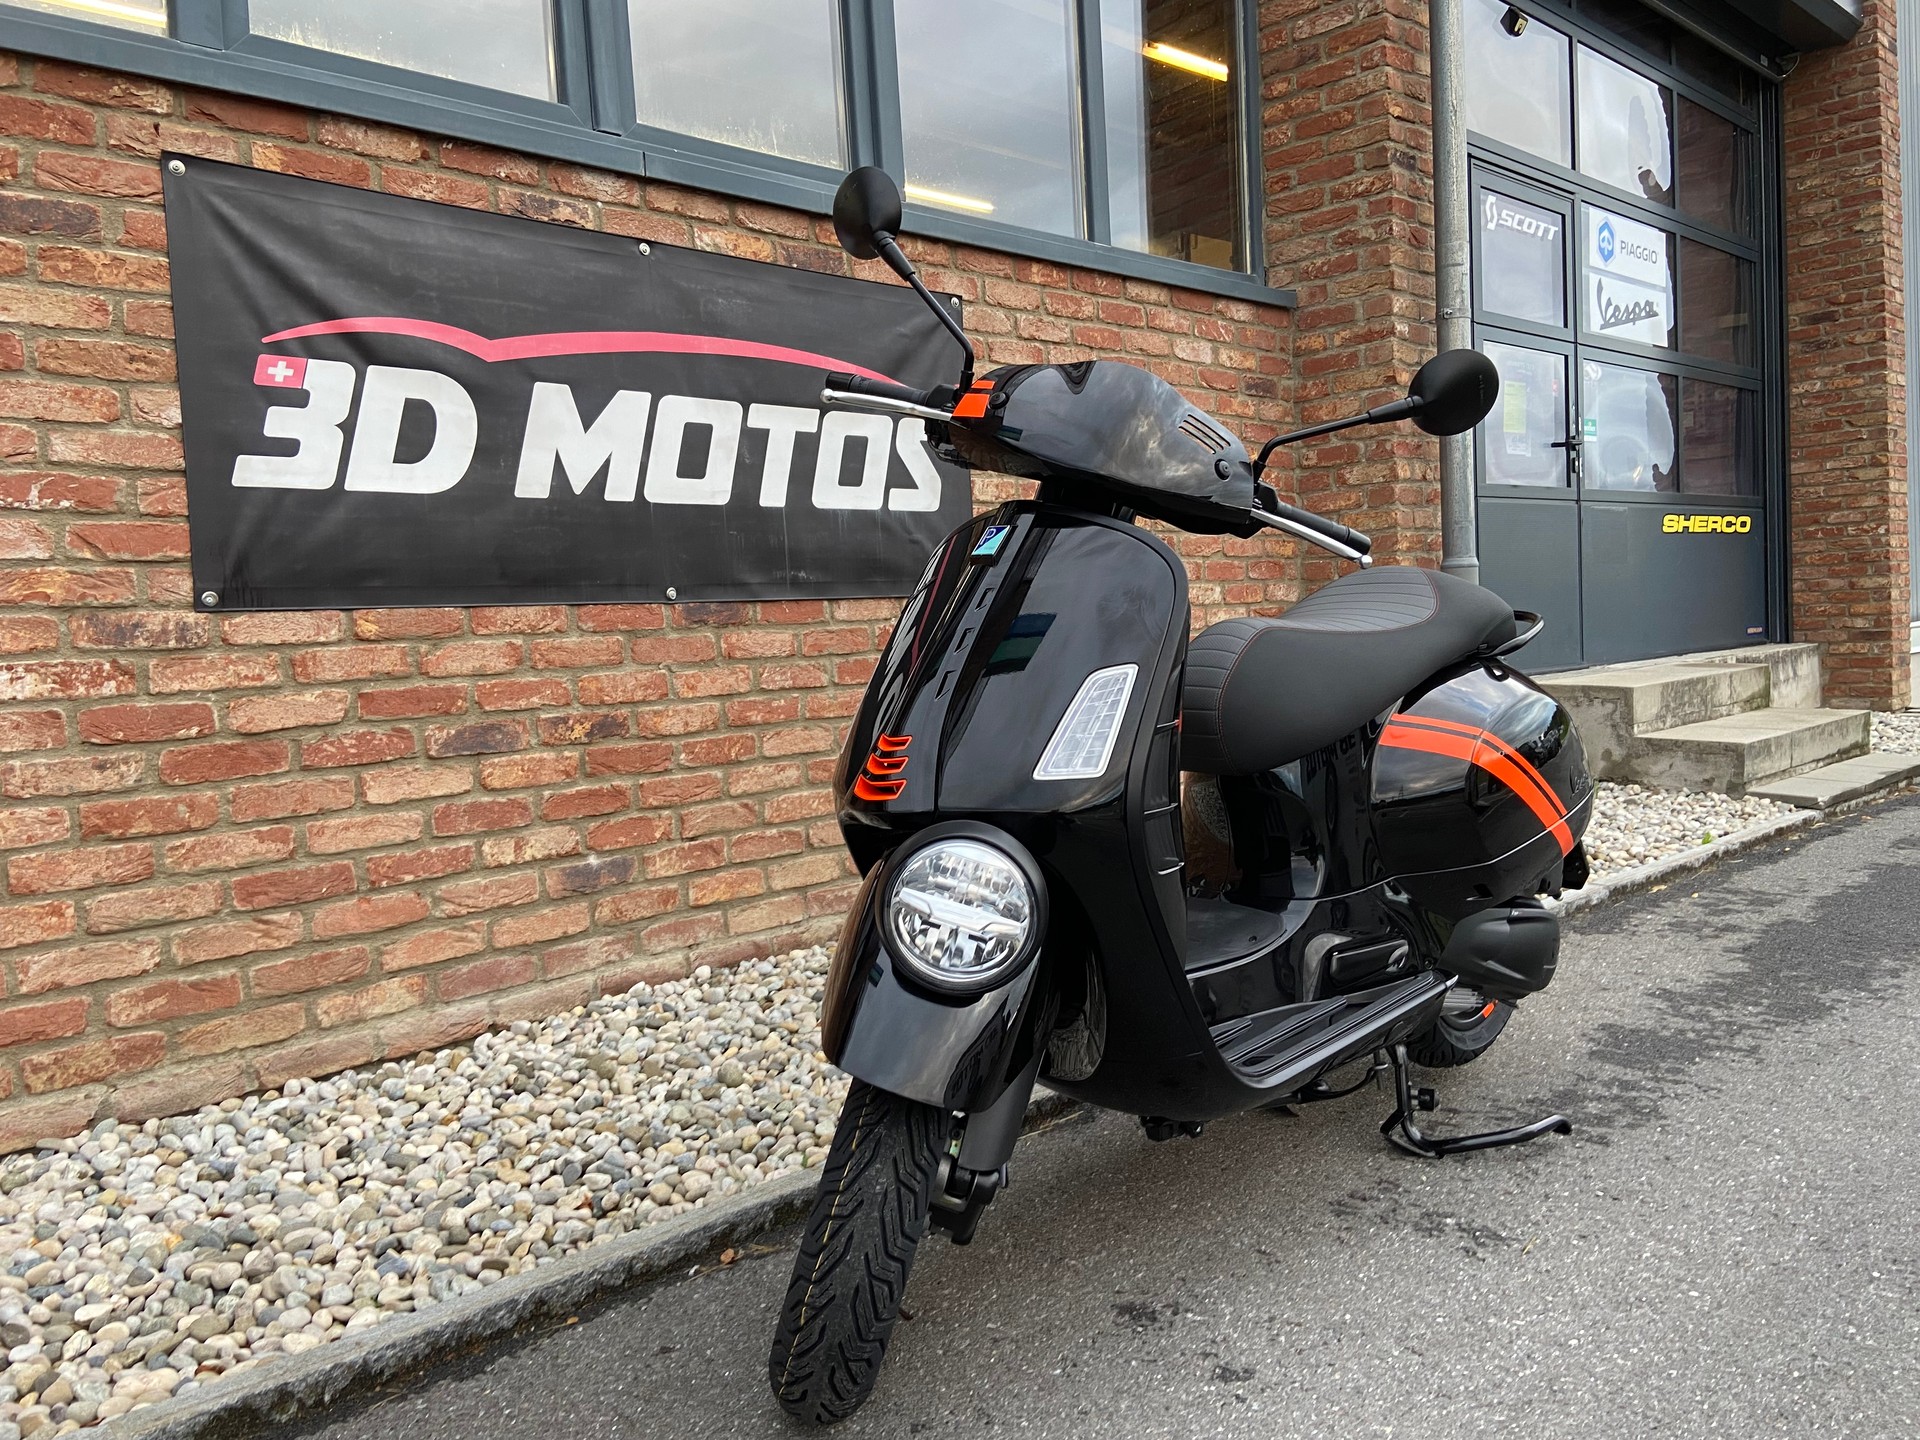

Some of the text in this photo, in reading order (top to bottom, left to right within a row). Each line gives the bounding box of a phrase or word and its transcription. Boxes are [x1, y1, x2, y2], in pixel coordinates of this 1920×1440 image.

[1498, 209, 1559, 241] SCOTT
[1620, 240, 1658, 264] PIAGGIO
[1596, 277, 1660, 331] Vespa
[231, 354, 942, 512] 3D MOTOS
[1662, 514, 1752, 534] SHERCO
